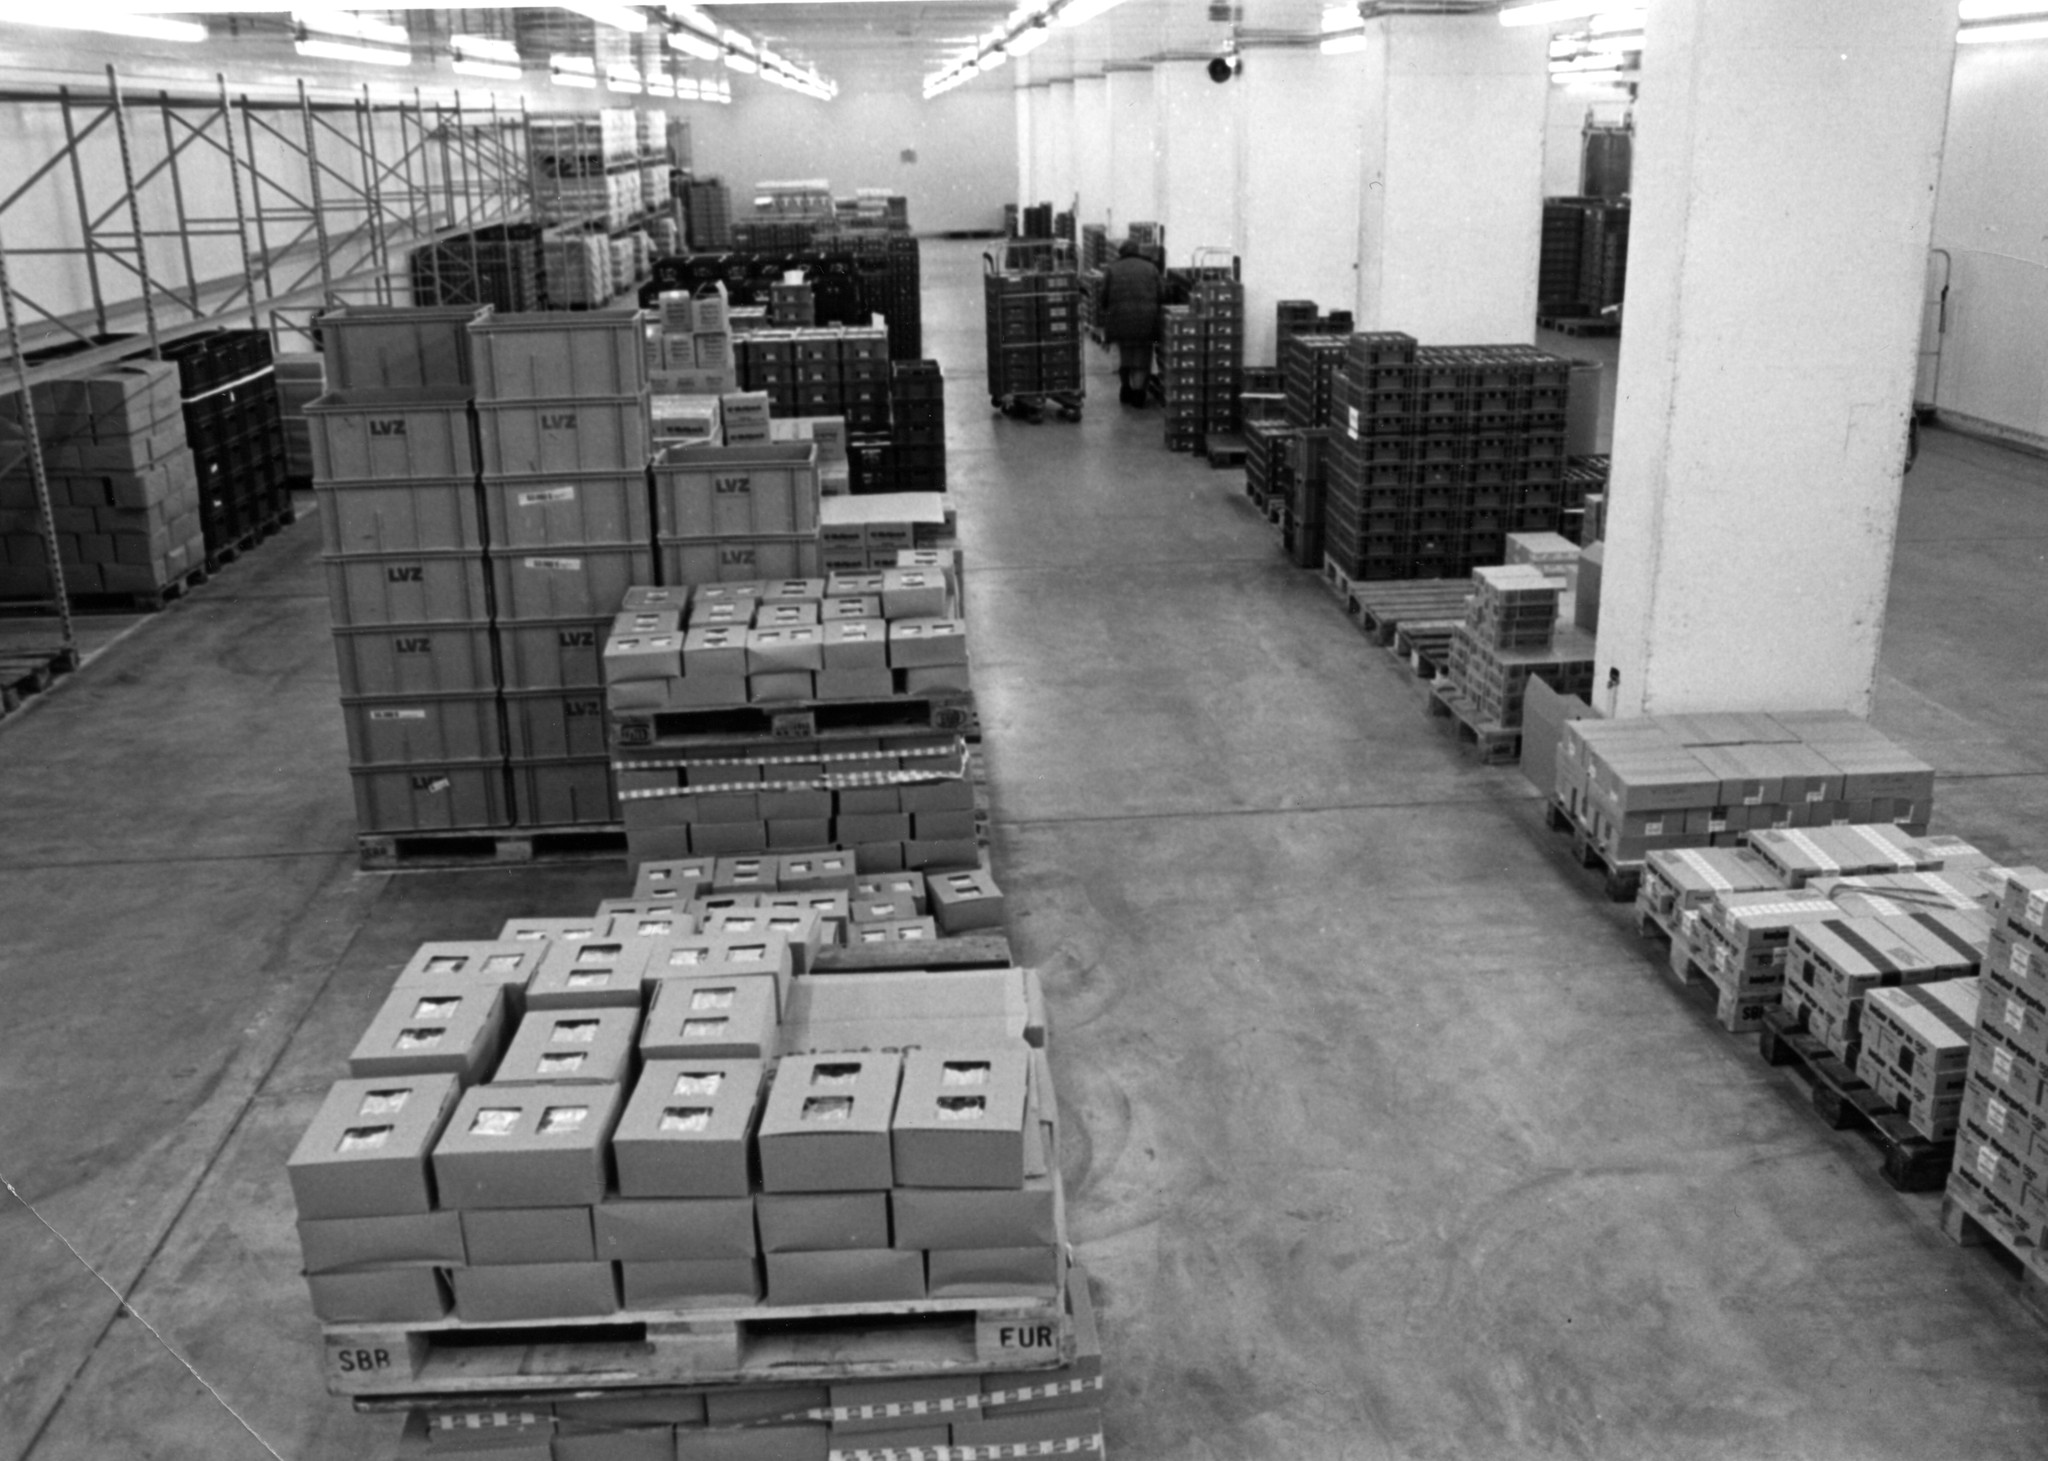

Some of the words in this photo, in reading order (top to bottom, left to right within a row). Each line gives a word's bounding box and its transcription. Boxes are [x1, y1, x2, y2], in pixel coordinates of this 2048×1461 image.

[369, 419, 406, 436] LVZ
[541, 413, 577, 430] LVZ
[715, 477, 751, 494] LVZ
[720, 548, 756, 565] LVZ
[387, 566, 424, 583] LVZ
[396, 637, 432, 654] LVZ
[559, 631, 595, 648] LVZ
[565, 701, 600, 717] LVZ
[999, 1325, 1052, 1349] EUR
